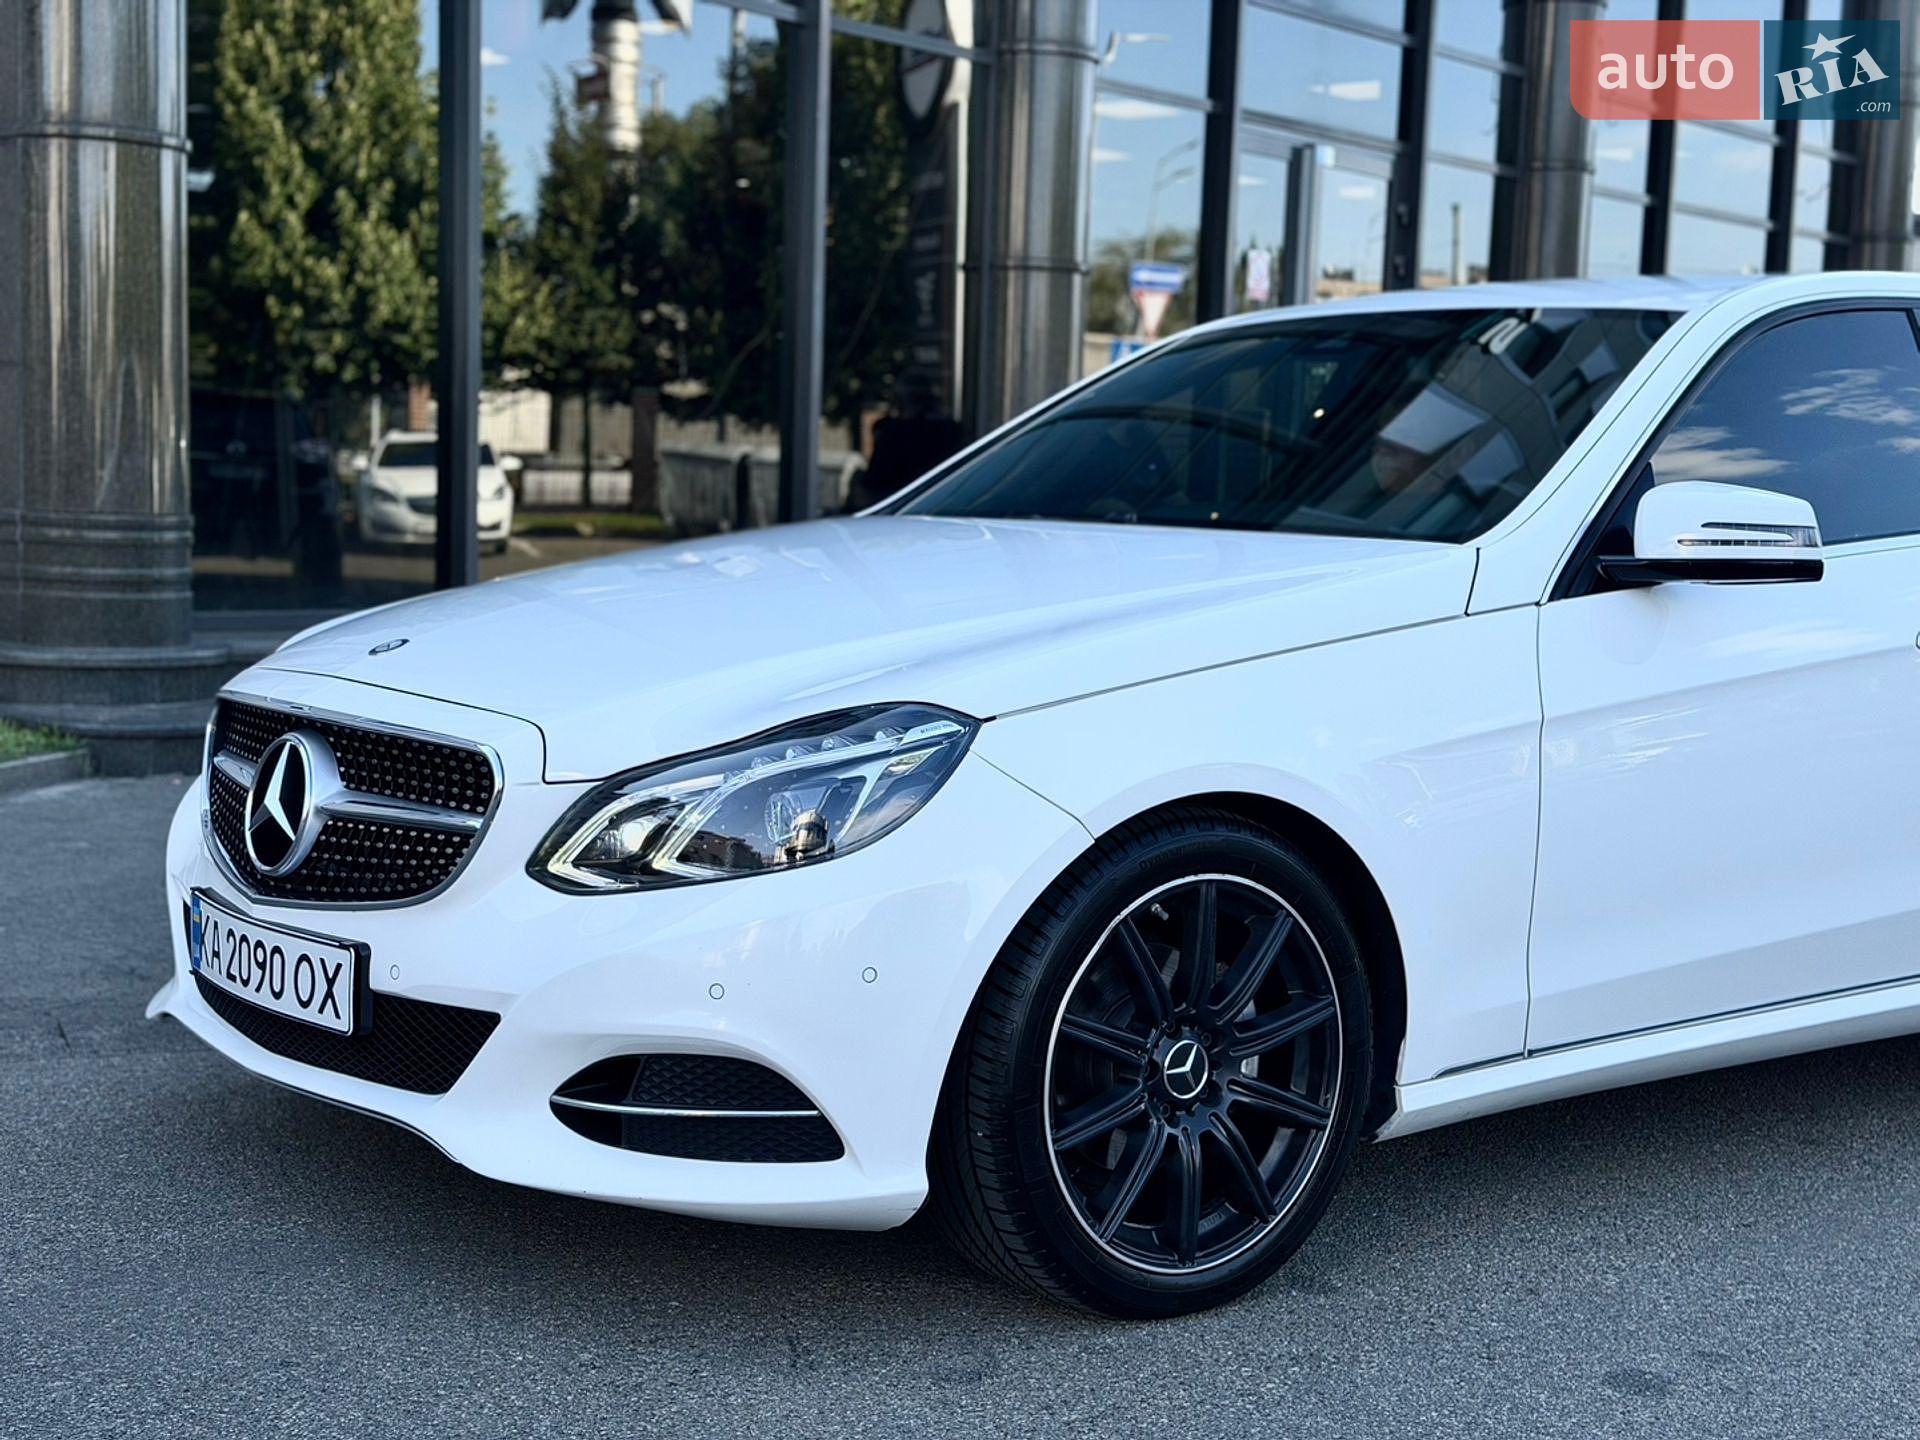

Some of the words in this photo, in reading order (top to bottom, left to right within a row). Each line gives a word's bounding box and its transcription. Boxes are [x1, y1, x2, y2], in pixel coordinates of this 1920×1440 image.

[200, 915, 223, 976] KA
[225, 928, 286, 1001] 2090
[293, 953, 343, 1020] OX
